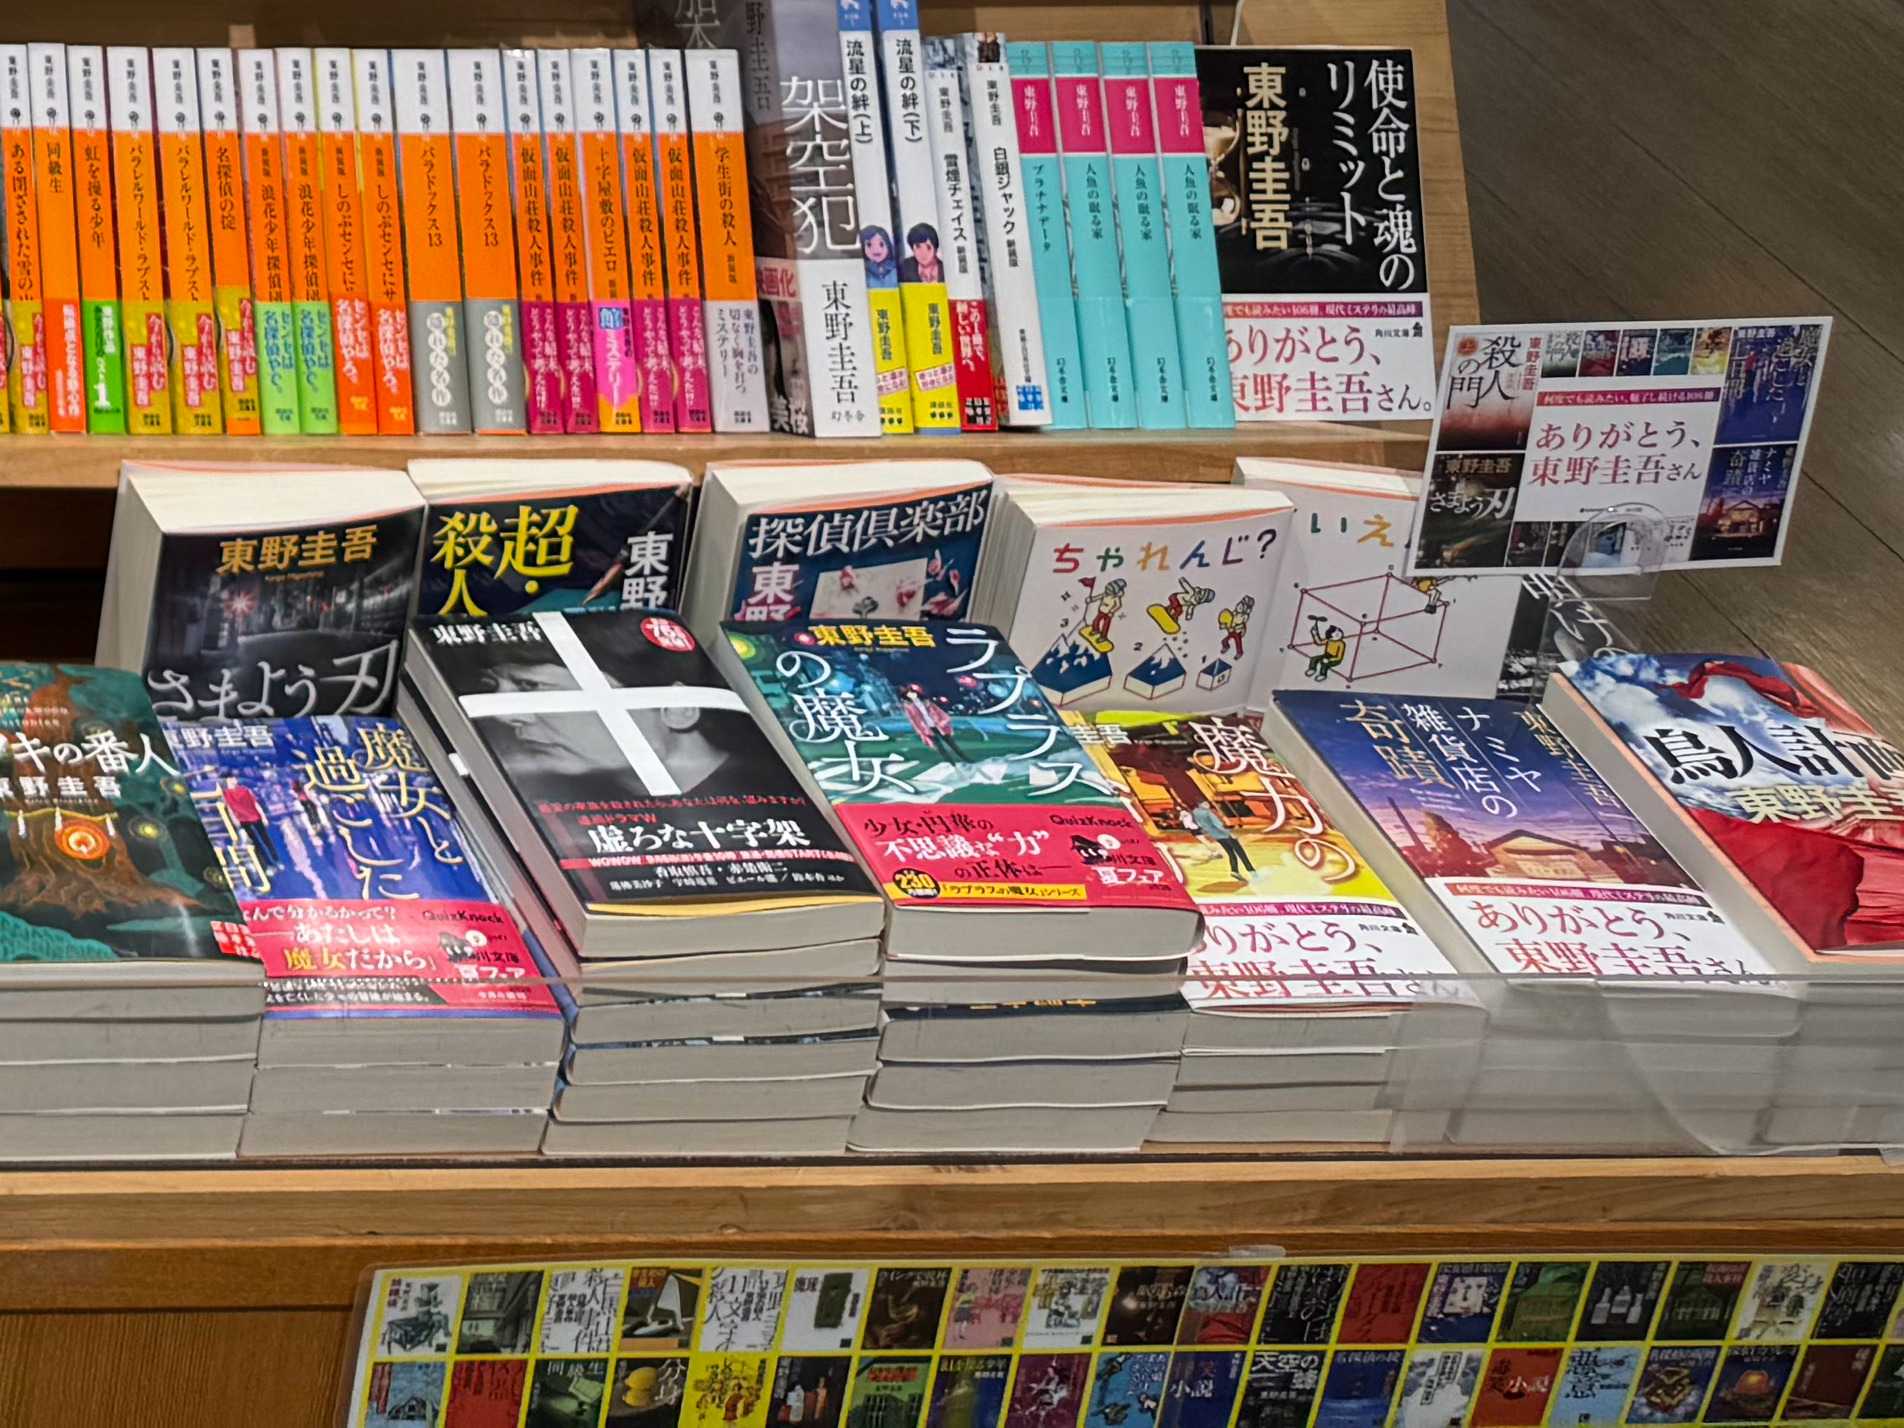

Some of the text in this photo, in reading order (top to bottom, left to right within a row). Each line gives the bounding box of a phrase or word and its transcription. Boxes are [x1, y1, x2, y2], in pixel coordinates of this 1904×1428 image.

[84, 144, 106, 249] 虹を操る少年
[215, 146, 237, 233] 名探偵の掟
[712, 144, 739, 247] 学生街の殺人
[782, 76, 862, 252] 架空犯
[992, 146, 1017, 238] 白銀ジャック
[1326, 64, 1372, 247] リミット
[1365, 63, 1417, 291] 使命と魂の
[1528, 454, 1703, 487] 東野圭吾さん
[1535, 421, 1702, 451] ありがとう、
[746, 488, 988, 562] 探偵倶楽部
[1429, 486, 1517, 520] さまよう刃
[149, 639, 399, 719] さまよう刃
[946, 626, 1127, 796] ラプラス
[1341, 699, 1455, 788] 奇蹟
[1407, 703, 1518, 819] 雑貨店の
[1456, 705, 1546, 794] ナミヤ
[588, 819, 812, 855] 虚ろな十字架
[1188, 720, 1356, 882] 魔力の
